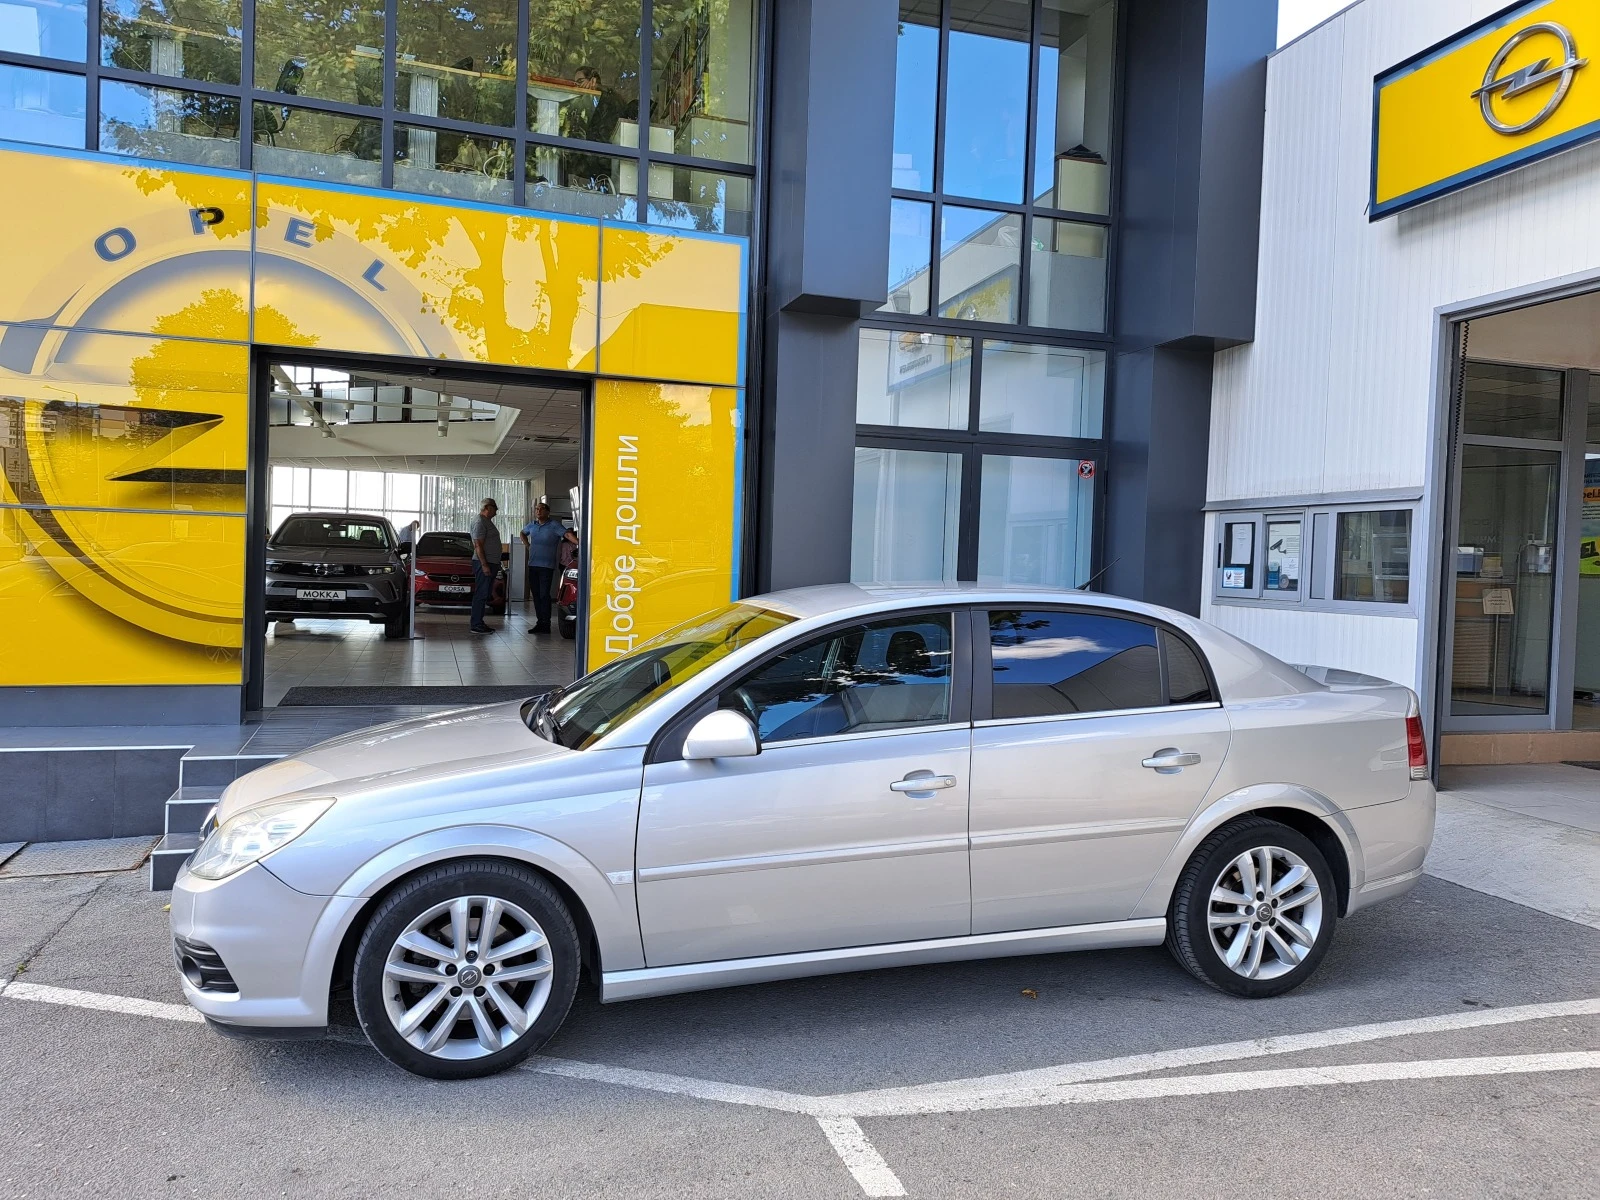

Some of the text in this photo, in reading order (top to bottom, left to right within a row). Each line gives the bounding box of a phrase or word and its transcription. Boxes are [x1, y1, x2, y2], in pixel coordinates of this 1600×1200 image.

[94, 206, 388, 292] OPEL
[605, 435, 642, 655] Добре дошли
[302, 590, 340, 599] MOKKA
